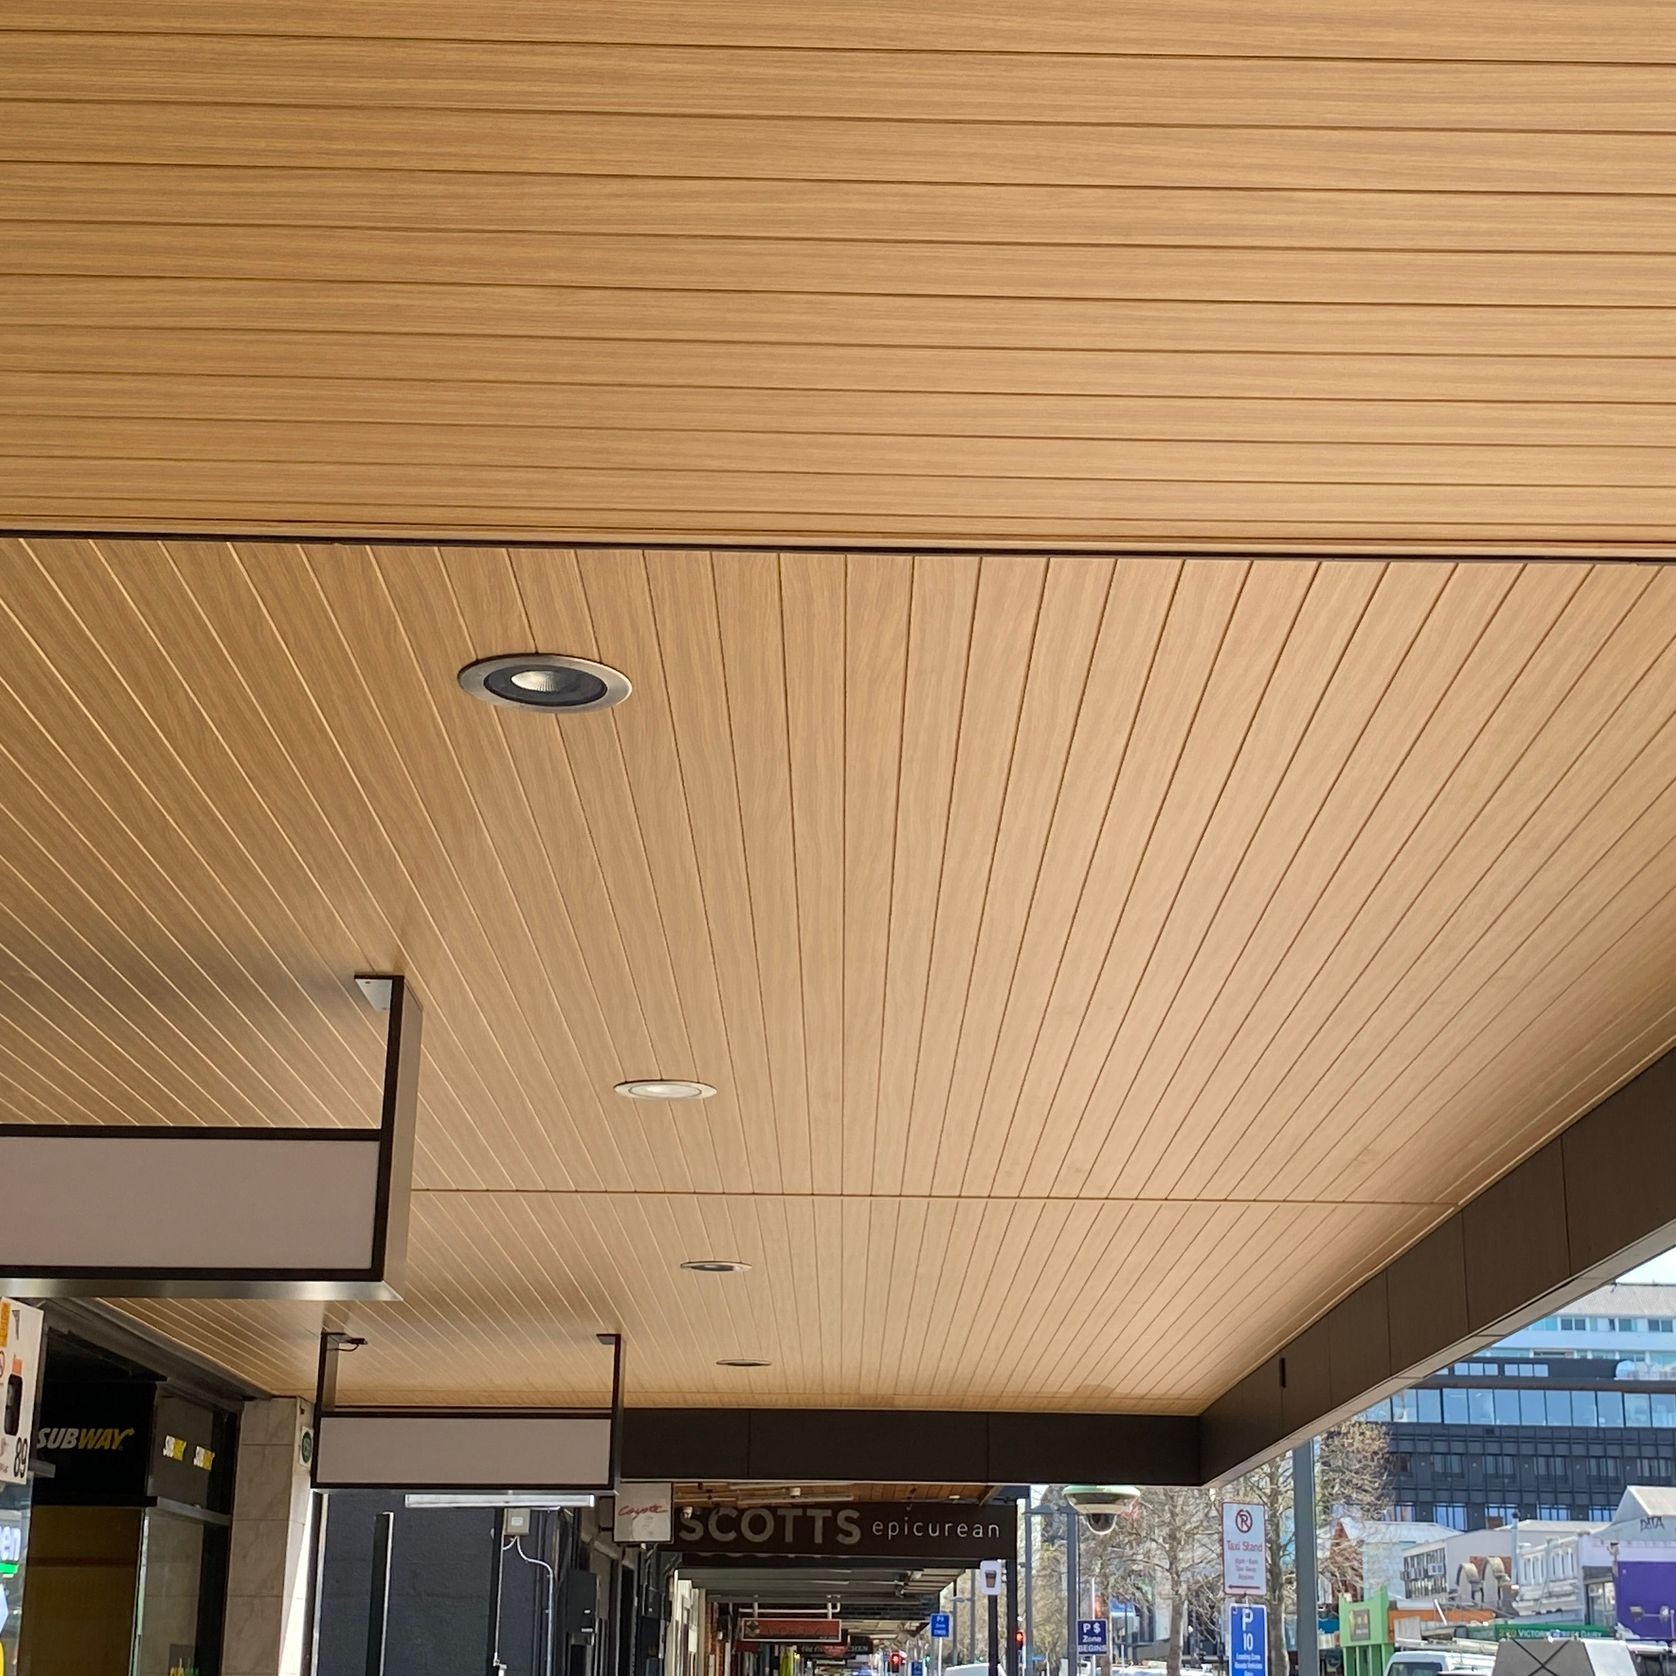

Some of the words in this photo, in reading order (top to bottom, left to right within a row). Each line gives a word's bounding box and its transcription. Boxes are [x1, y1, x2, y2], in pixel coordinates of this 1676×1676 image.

[36, 1428, 134, 1450] SUBWAY
[13, 1437, 28, 1478] 89
[679, 1506, 862, 1545] SCOTTS
[872, 1516, 1000, 1540] epicurean
[1227, 1541, 1241, 1552] Taxi
[1242, 1541, 1263, 1553] Stand
[1242, 1608, 1254, 1631] P
[1243, 1633, 1254, 1651] 10
